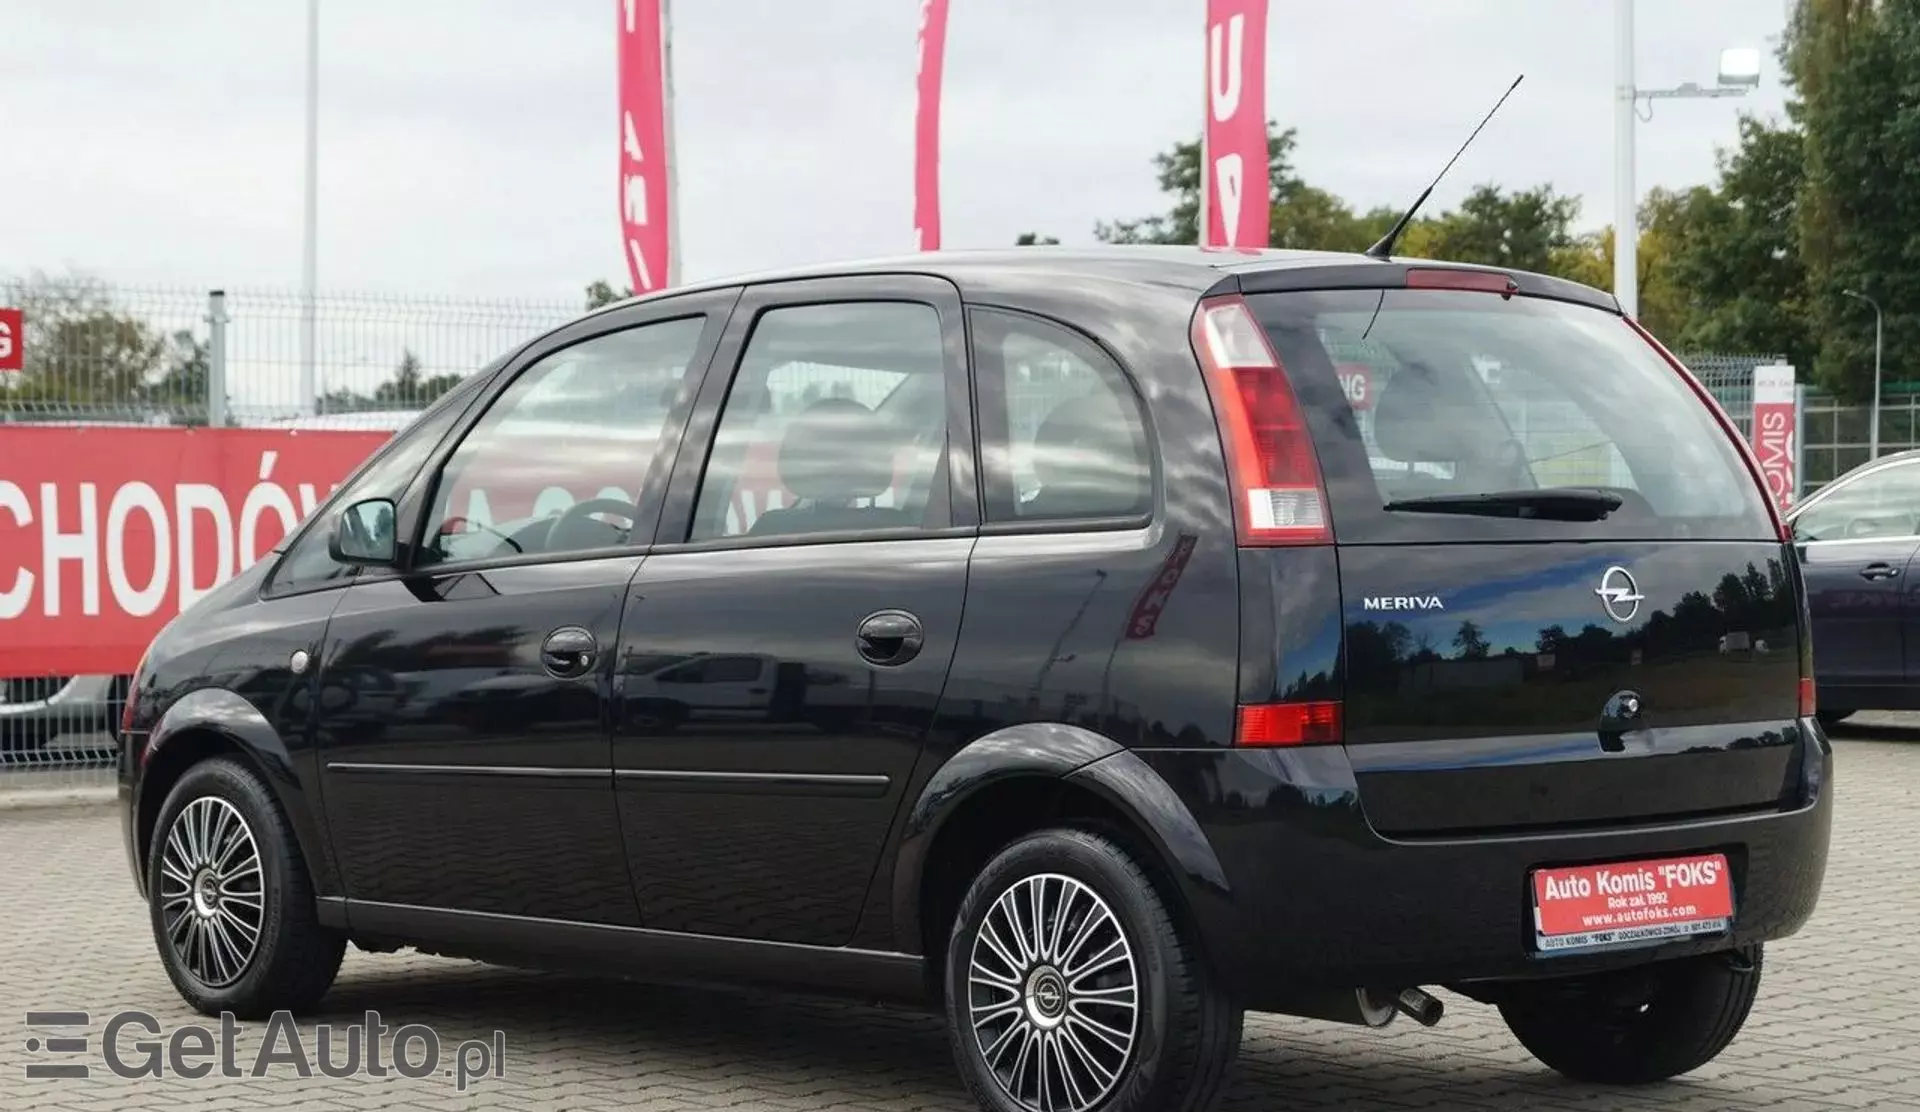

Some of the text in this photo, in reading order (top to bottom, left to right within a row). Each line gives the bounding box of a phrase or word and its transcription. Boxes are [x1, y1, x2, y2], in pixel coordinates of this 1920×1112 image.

[1762, 412, 1785, 505] OMIS
[0, 451, 338, 619] CHODÓ
[1363, 596, 1444, 610] MERIVA
[1545, 861, 1722, 900] Auto Komis "FOKS"
[1582, 904, 1697, 927] www.autofoks.com
